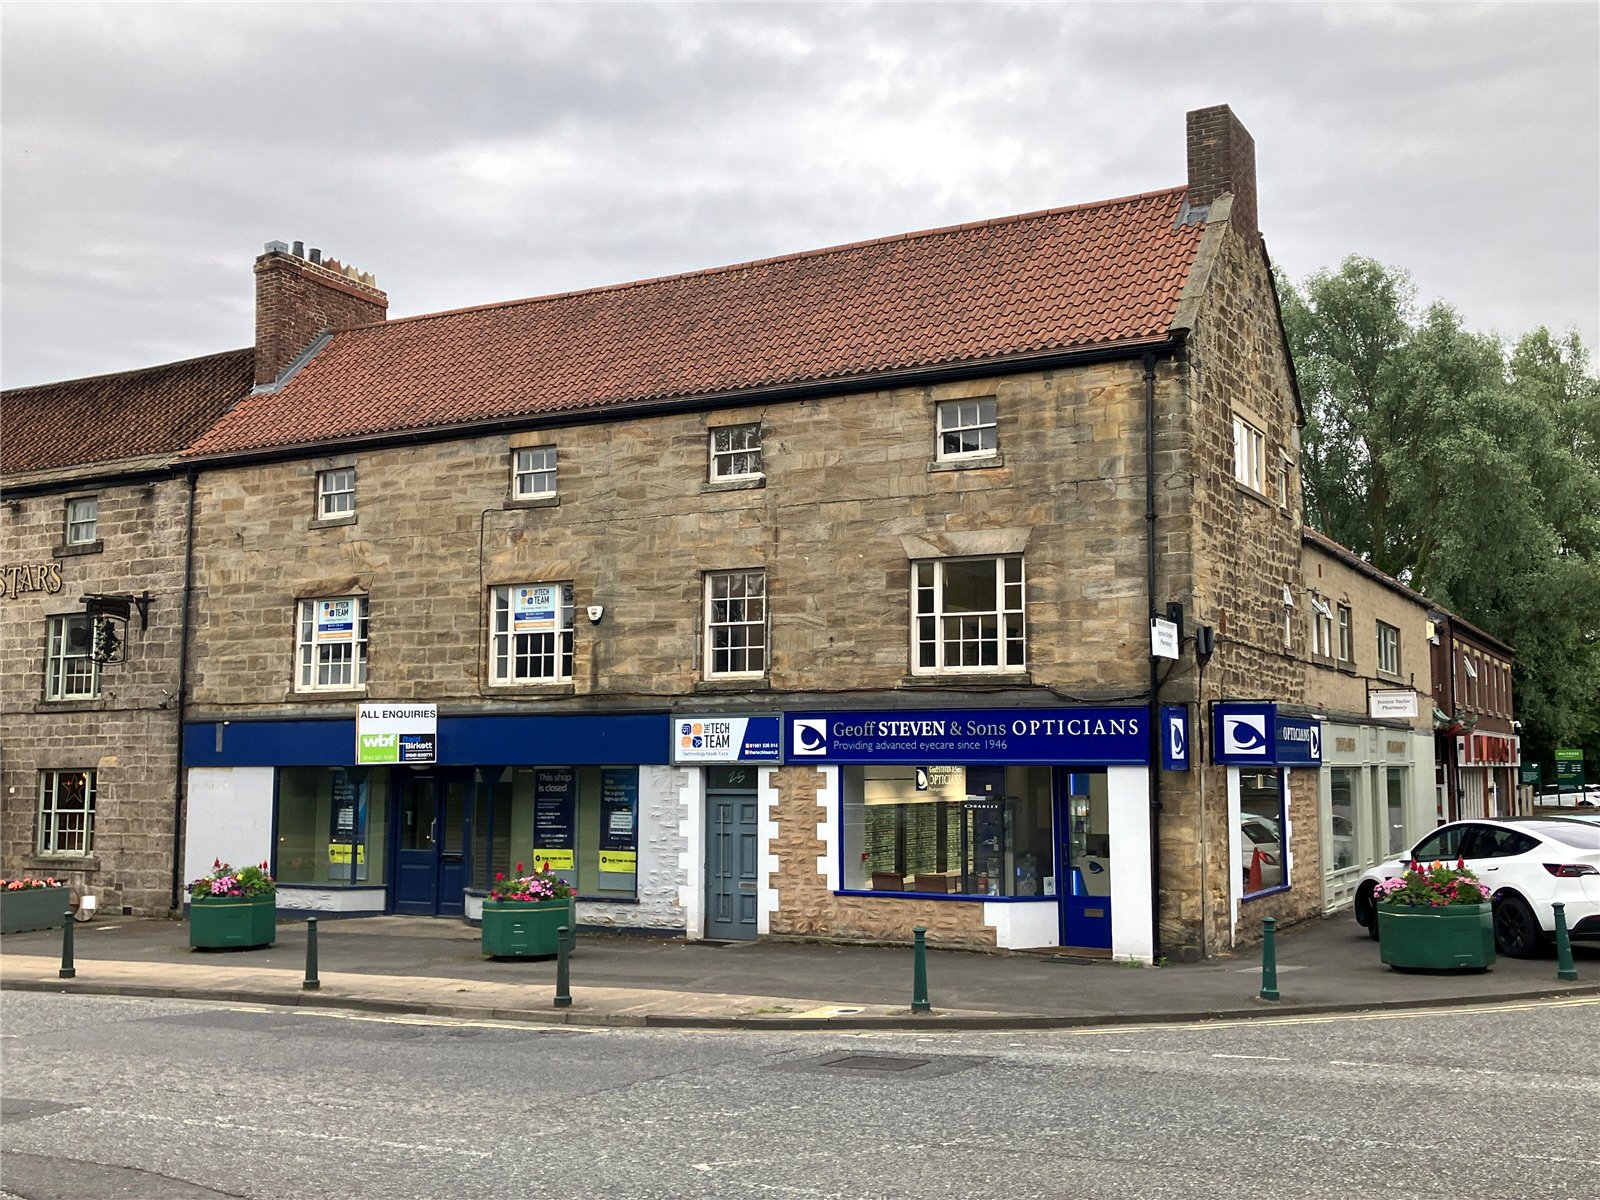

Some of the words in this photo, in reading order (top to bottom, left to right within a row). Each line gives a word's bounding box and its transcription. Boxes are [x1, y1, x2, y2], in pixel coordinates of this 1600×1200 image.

[534, 596, 550, 604] TEAM
[360, 710, 379, 718] ALL
[382, 710, 436, 719] ENQUIRIES
[711, 723, 730, 734] TECH
[833, 721, 875, 736] Geoff
[878, 721, 945, 736] STEVEN
[950, 721, 962, 736] &
[966, 720, 1006, 736] Sons
[1012, 719, 1138, 736] OPTICIANS
[1283, 727, 1310, 741] OPTICIANS
[704, 735, 730, 748] TEAM
[833, 741, 873, 752] Providing
[876, 741, 916, 750] advanced
[920, 742, 954, 752] eyecare
[957, 740, 980, 749] since
[985, 740, 1007, 749] 1946
[538, 773, 553, 782] This
[554, 773, 572, 783] shop
[728, 770, 746, 783] 25
[930, 774, 962, 785] OPTICIANS
[538, 784, 544, 792] is
[545, 783, 567, 792] closed
